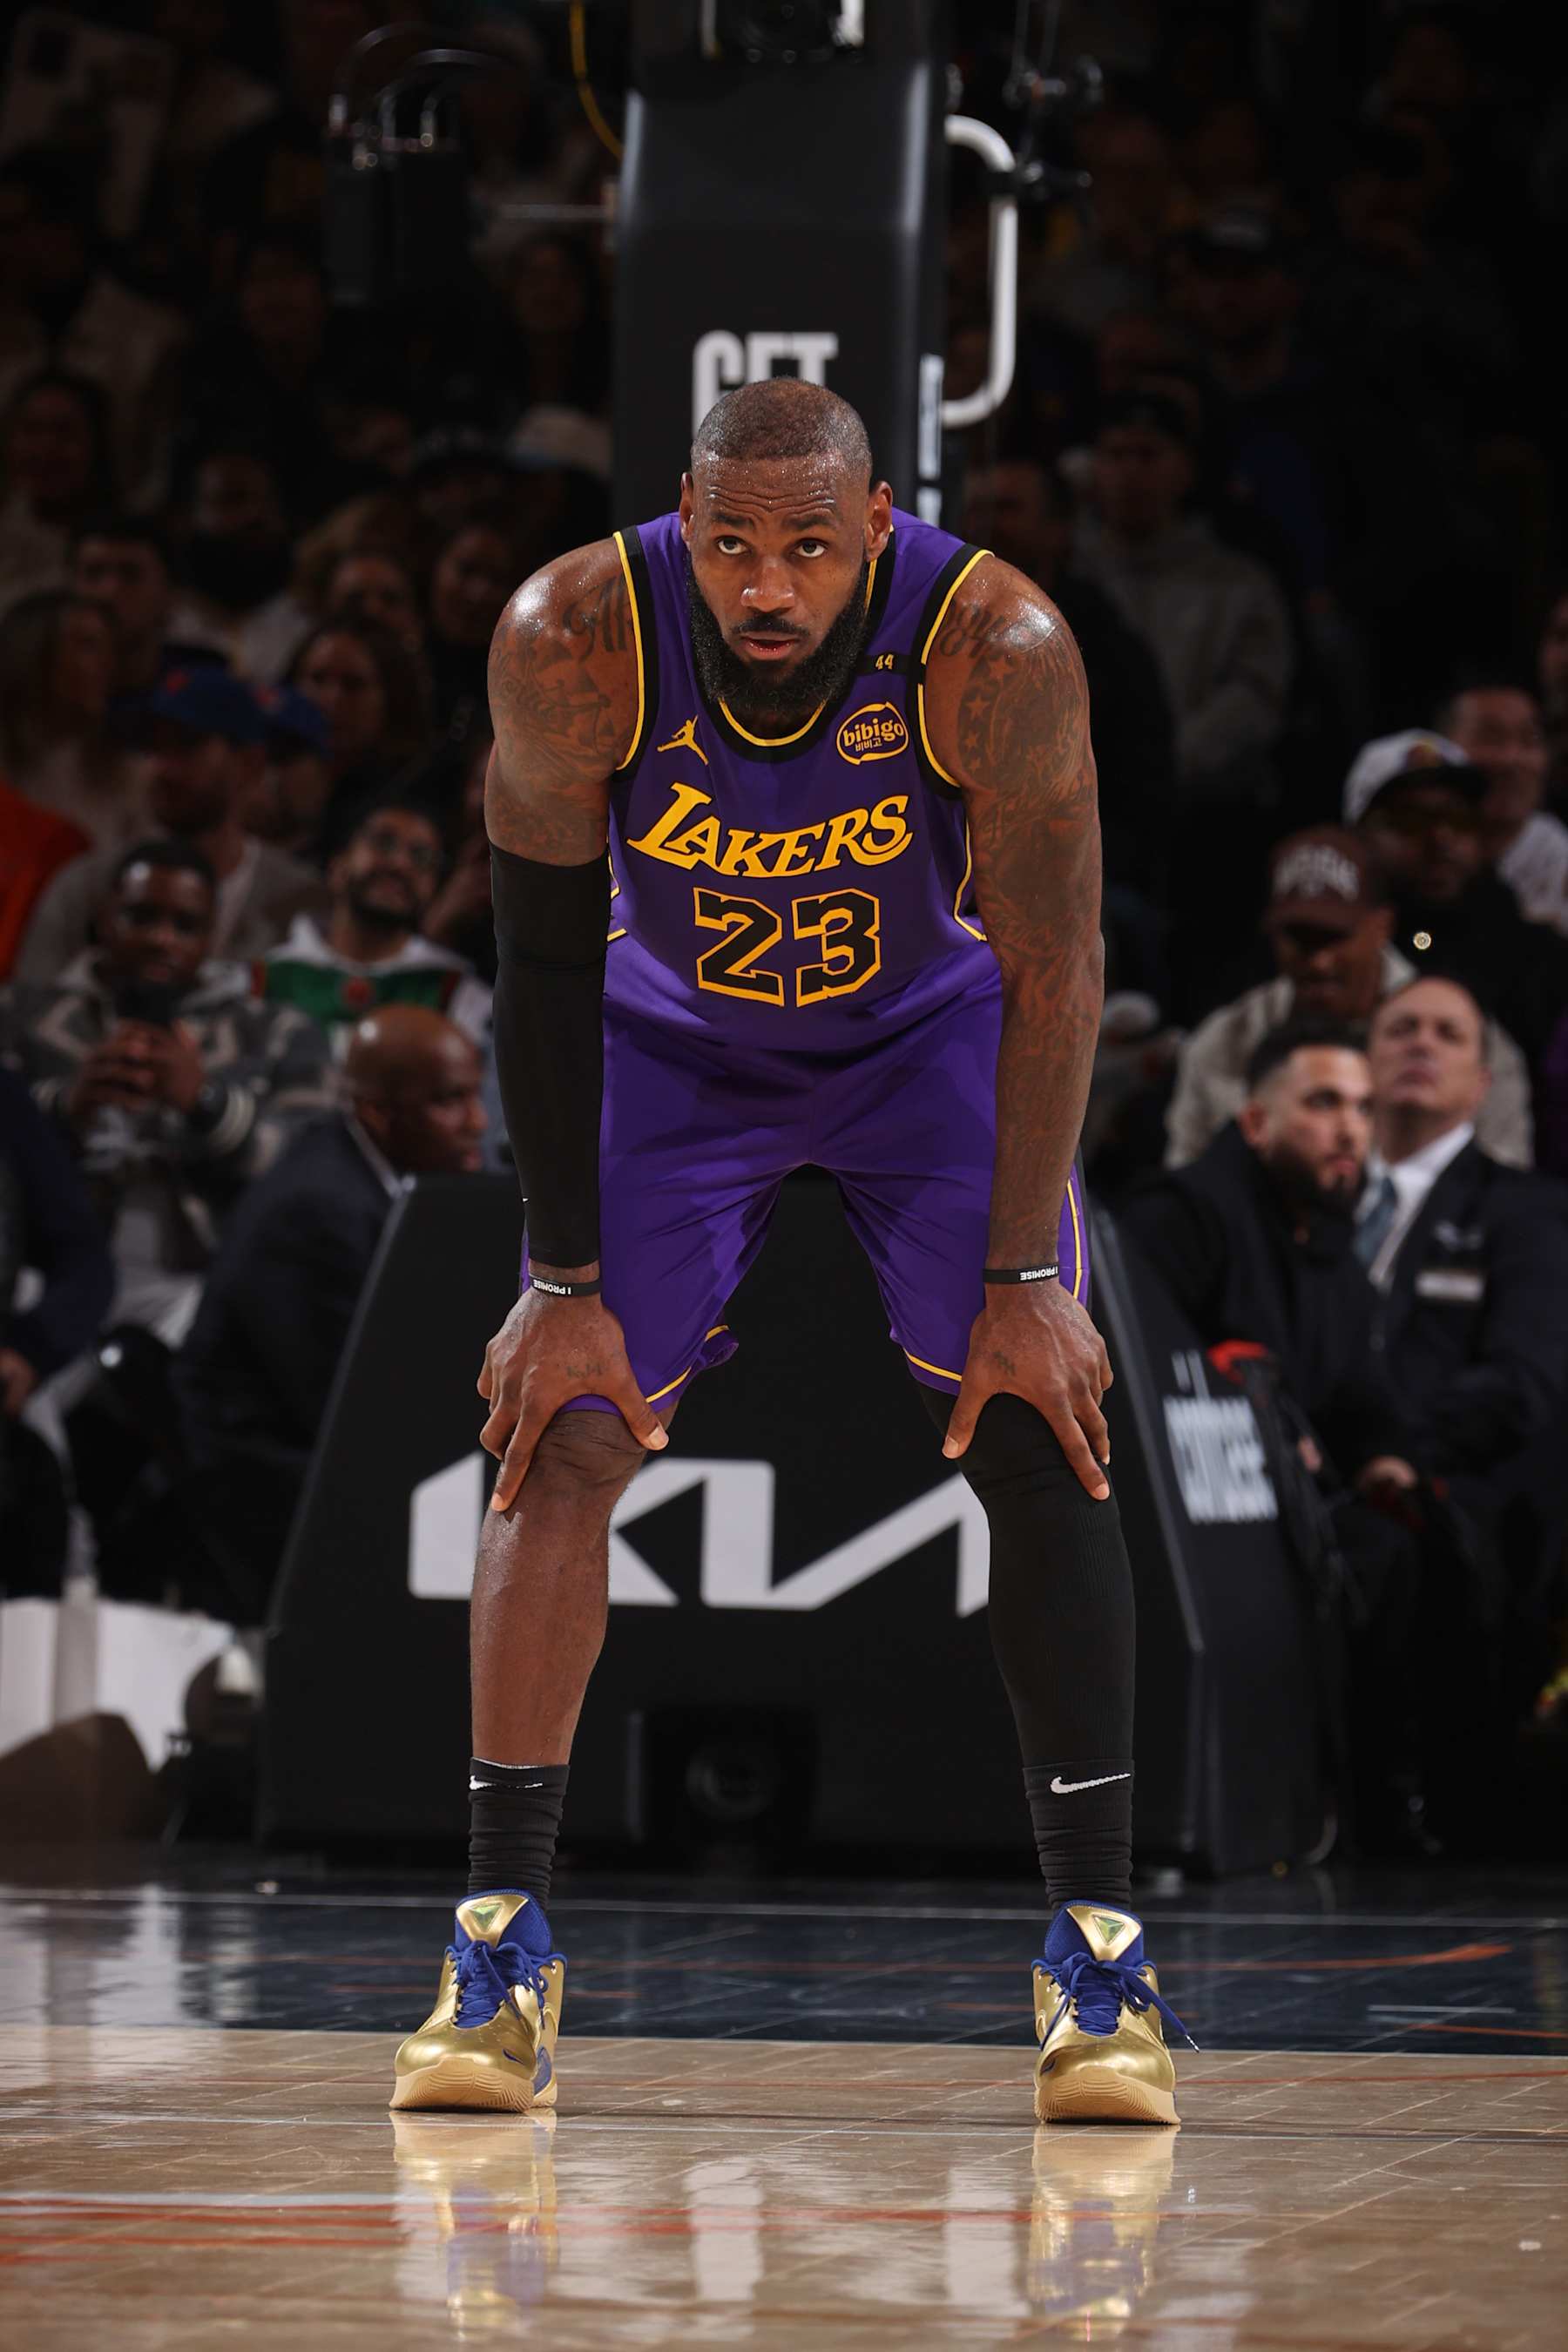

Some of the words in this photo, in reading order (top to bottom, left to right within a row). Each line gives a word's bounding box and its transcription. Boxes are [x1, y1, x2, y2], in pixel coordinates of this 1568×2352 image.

[875, 653, 894, 670] 44
[843, 719, 904, 747] bibigo
[855, 737, 882, 753] 비비고
[626, 781, 913, 878] LAKERS
[693, 887, 882, 1008] 23
[1020, 1267, 1055, 1281] PROMISE
[533, 1280, 566, 1294] PROMISE
